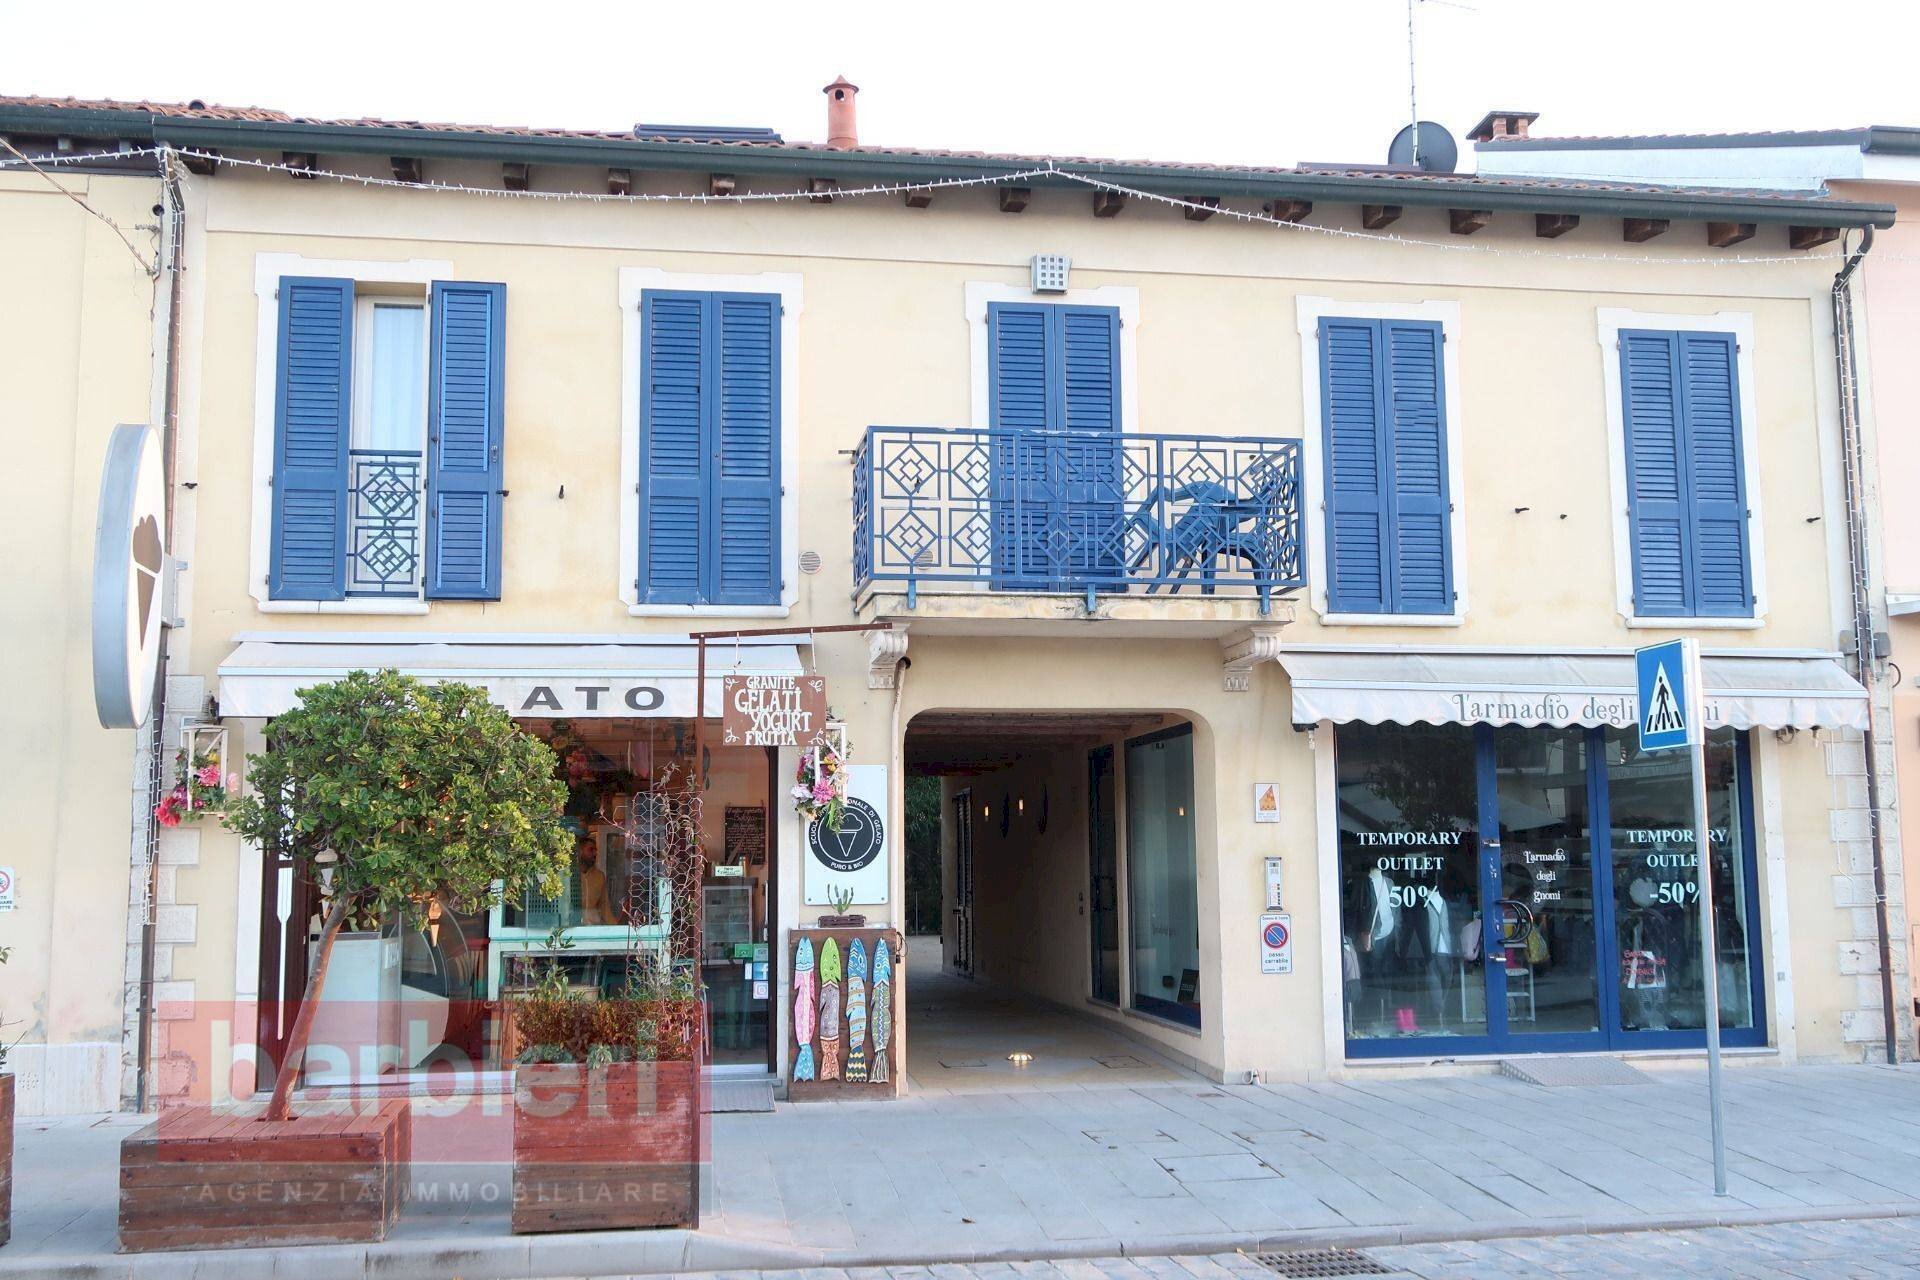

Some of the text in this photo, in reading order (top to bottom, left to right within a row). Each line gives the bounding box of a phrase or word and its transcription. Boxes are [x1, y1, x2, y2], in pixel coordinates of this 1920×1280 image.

[746, 676, 795, 690] GRANITE
[477, 686, 665, 711] ATO
[1452, 693, 1635, 725] L'armadio degli
[749, 710, 812, 732] YOGURT
[745, 730, 797, 746] FRUTTA
[810, 819, 819, 845] SCUOL
[873, 819, 882, 845] GELATO
[1357, 831, 1462, 846] TEMPORARY
[1627, 829, 1727, 843] TEMPORRY
[1523, 848, 1566, 864] L'armadio
[1646, 854, 1699, 868] OUTLE
[1377, 857, 1444, 871] OUTLET
[1536, 870, 1556, 883] degli
[1533, 890, 1561, 903] gnomi
